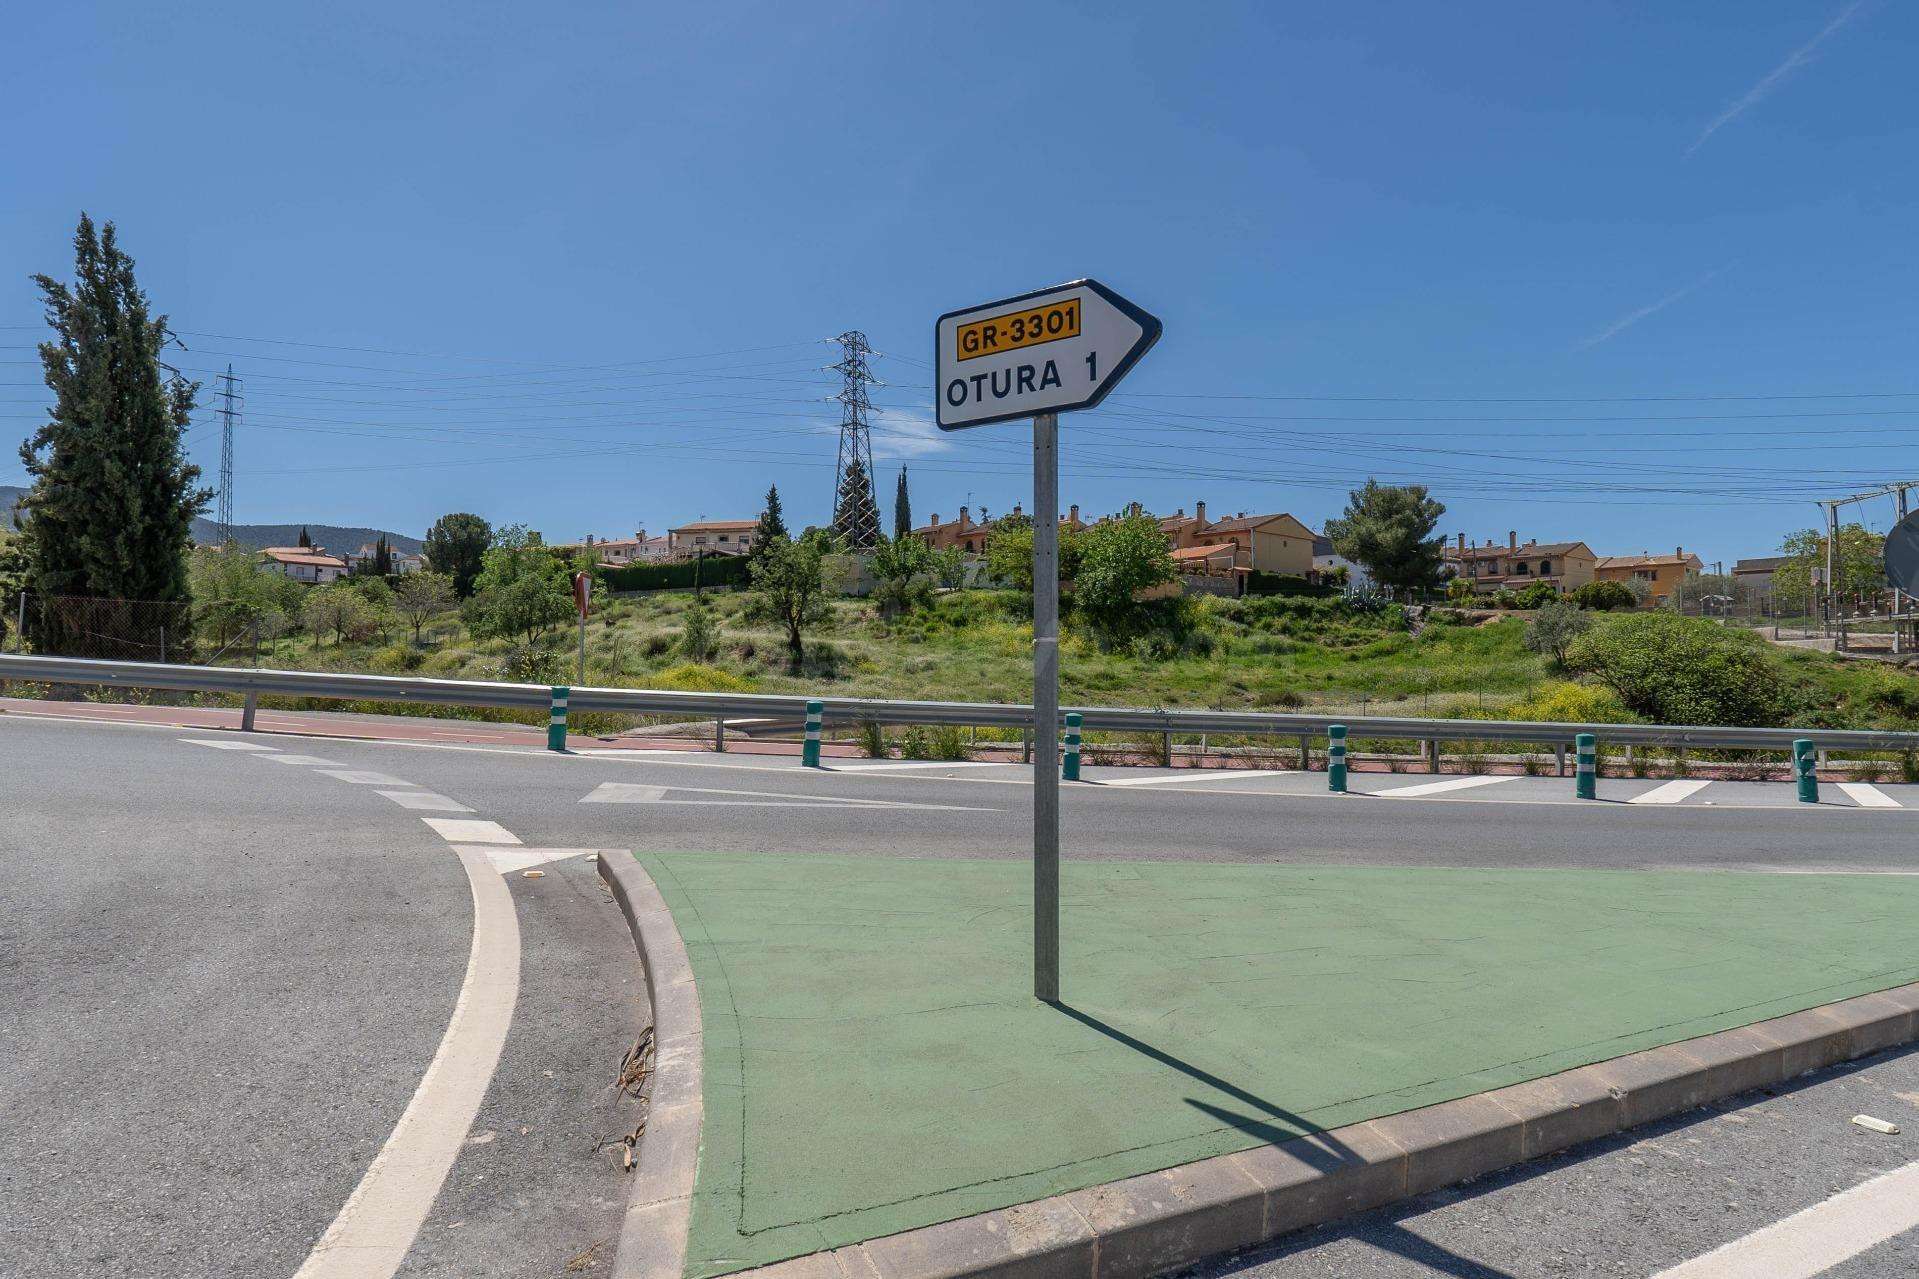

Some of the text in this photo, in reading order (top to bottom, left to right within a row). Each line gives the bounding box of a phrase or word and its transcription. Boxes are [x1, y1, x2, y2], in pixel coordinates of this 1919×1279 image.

[962, 306, 1075, 353] GR-3301
[946, 351, 1097, 407] OTURA 1
